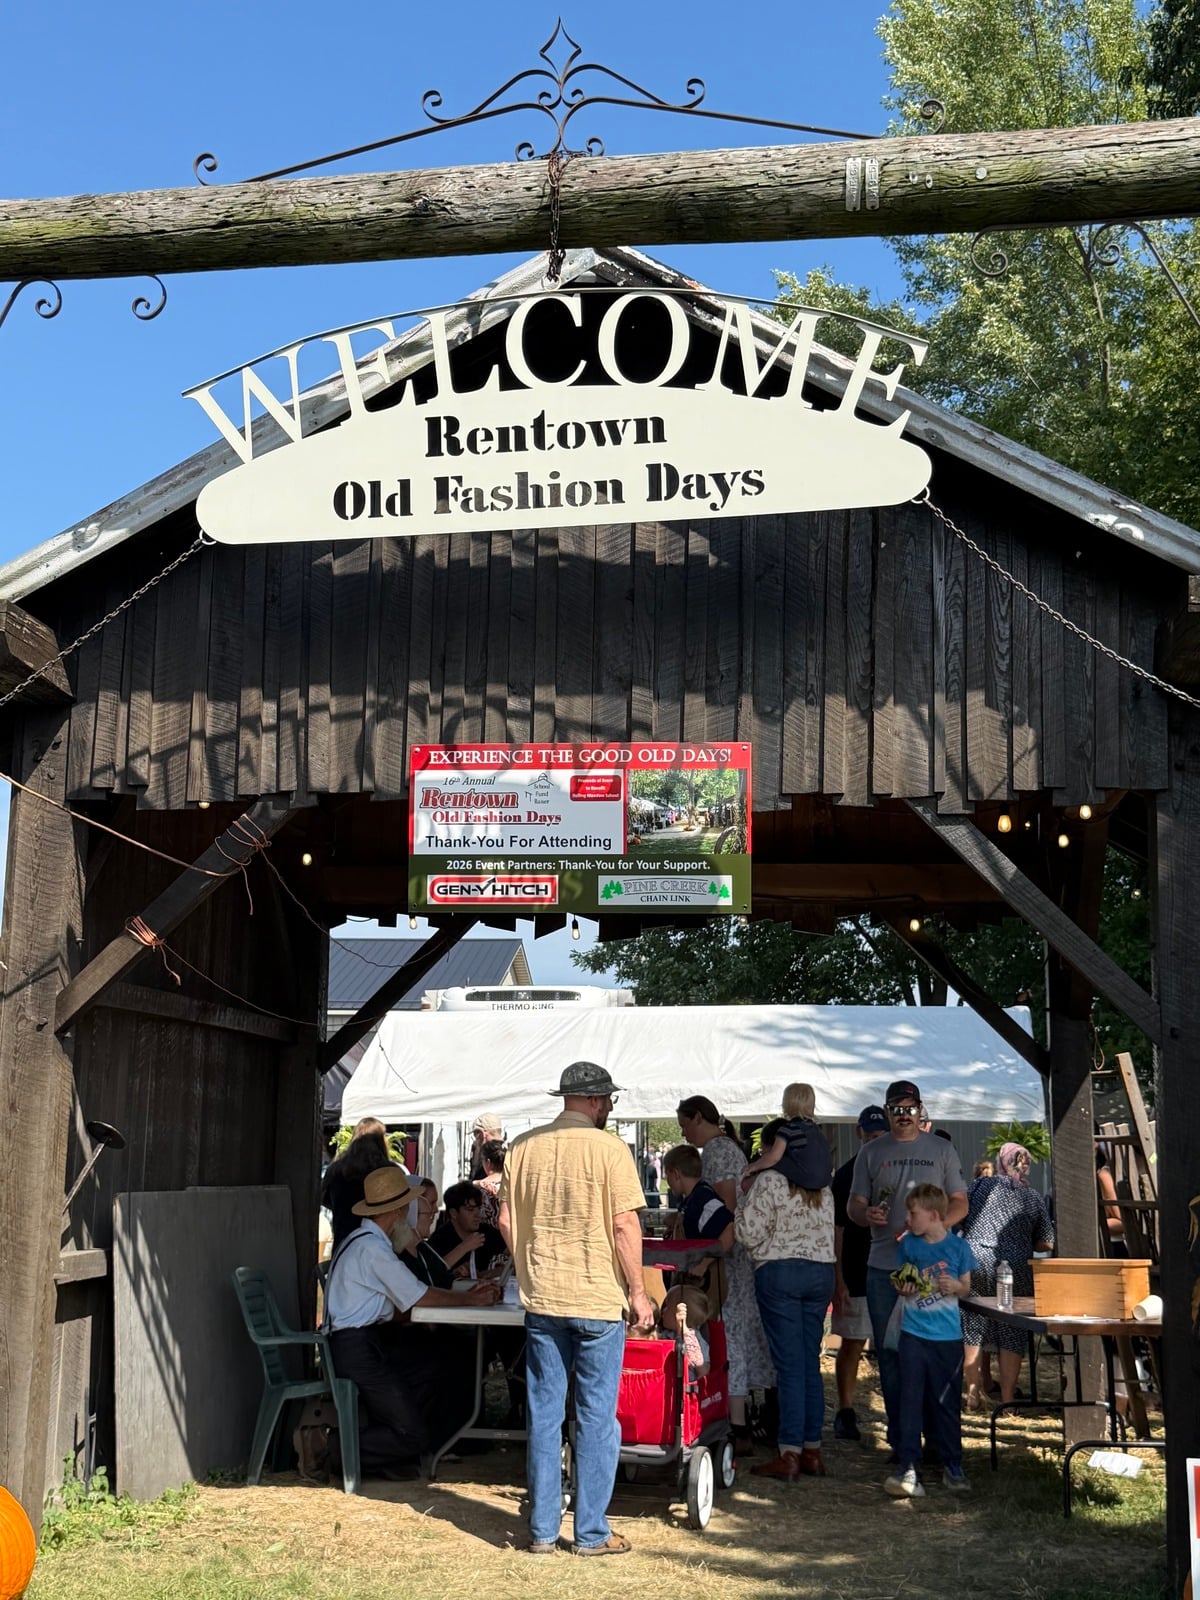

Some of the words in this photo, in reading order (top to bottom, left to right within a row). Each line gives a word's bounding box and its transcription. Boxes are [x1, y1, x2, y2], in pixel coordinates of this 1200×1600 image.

[182, 290, 930, 461] WELCOME
[424, 409, 668, 458] Rentown
[333, 478, 414, 521] Old
[433, 470, 626, 515] Fashion
[645, 462, 766, 512] Days
[428, 750, 533, 764] EXPERIENCE
[538, 749, 573, 763] THE
[578, 749, 633, 763] GOOD
[638, 748, 676, 763] OLD
[682, 748, 732, 762] DAYS!
[443, 776, 460, 785] 16th
[462, 776, 496, 785] Annual
[419, 787, 519, 809] Rentown
[432, 811, 460, 823] Old
[464, 811, 522, 823] Fashion
[526, 811, 562, 826] Days
[425, 835, 504, 848] Thank-You
[509, 835, 535, 848] For
[538, 835, 612, 850] Attending
[446, 860, 473, 870] 2026
[475, 860, 505, 870] Event
[507, 860, 556, 870] Partners:
[558, 860, 615, 870] Thank-You
[618, 860, 633, 870] for
[636, 860, 661, 870] Your
[663, 860, 711, 872] Support.
[492, 885, 548, 896] HITCH
[624, 881, 658, 893] PINE
[660, 880, 708, 893] CREEK
[640, 895, 669, 903] CHAIN
[671, 895, 691, 903] LINK
[491, 1003, 531, 1011] THERMO
[893, 1159, 934, 1167] FREEDOM
